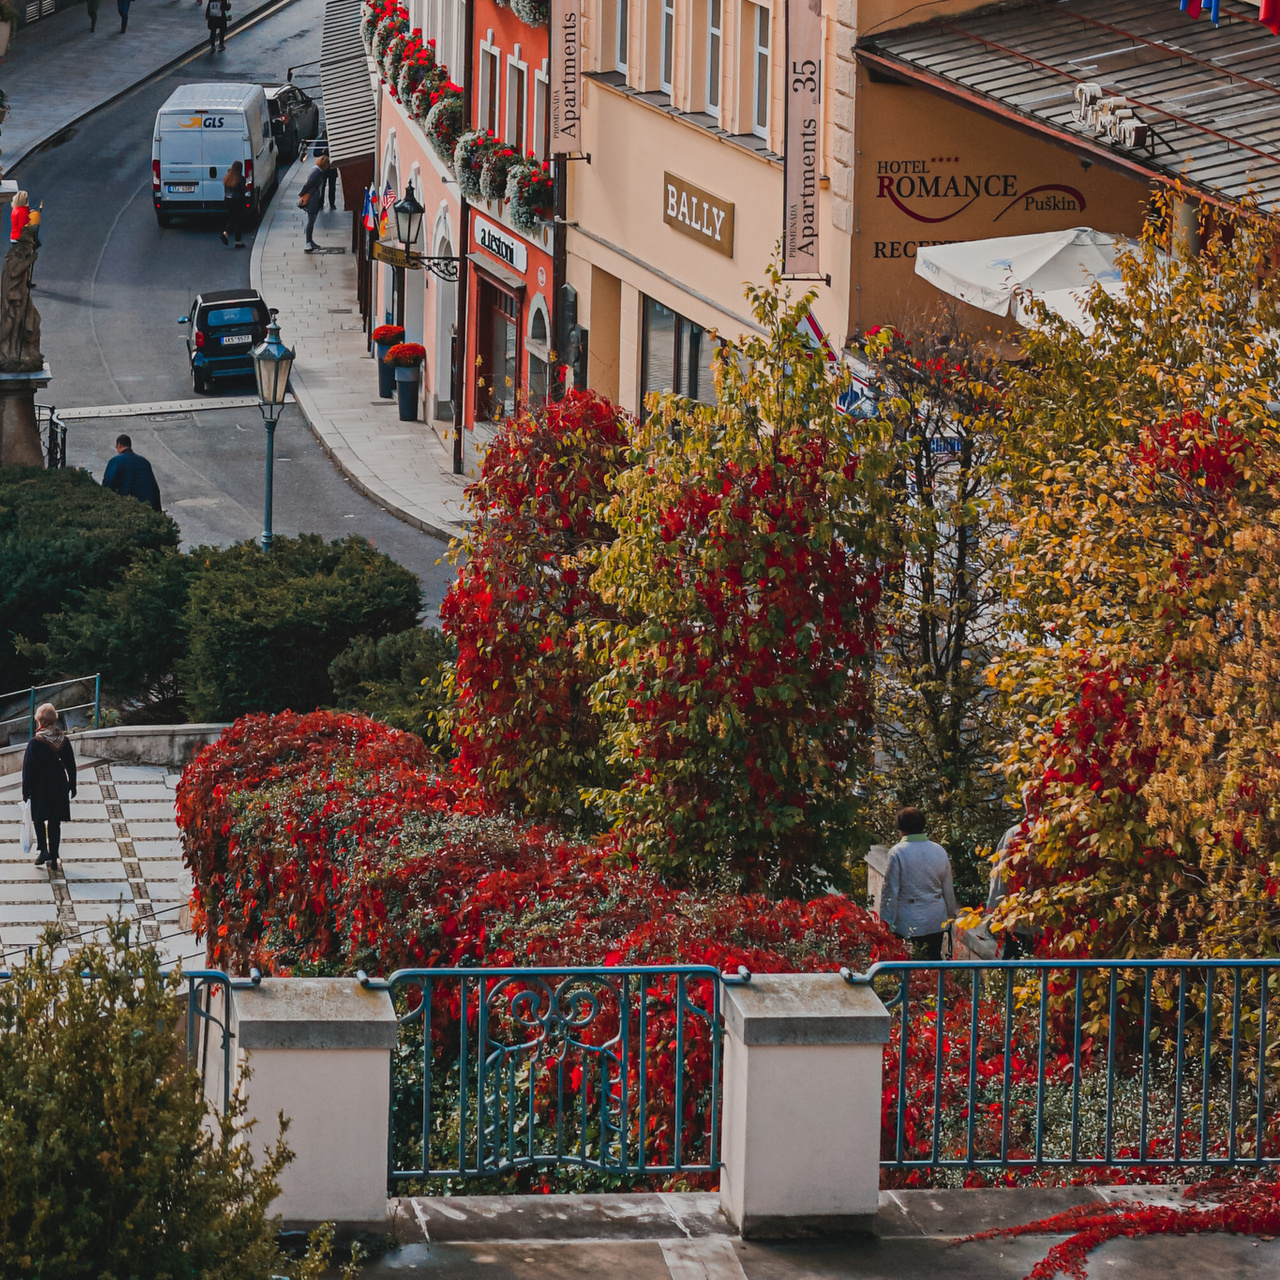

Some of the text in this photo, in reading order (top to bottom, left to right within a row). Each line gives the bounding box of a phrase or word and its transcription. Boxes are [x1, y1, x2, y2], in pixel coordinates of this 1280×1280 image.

[560, 12, 580, 139] Apartments
[792, 59, 817, 93] 35
[203, 117, 225, 129] GLS
[877, 160, 930, 174] HOTEL
[797, 118, 818, 257] Apartments
[876, 174, 1018, 198] ROMANCE
[666, 184, 726, 242] BALLY
[1024, 195, 1076, 212] Puškin
[788, 203, 798, 258] PROMENÁDA
